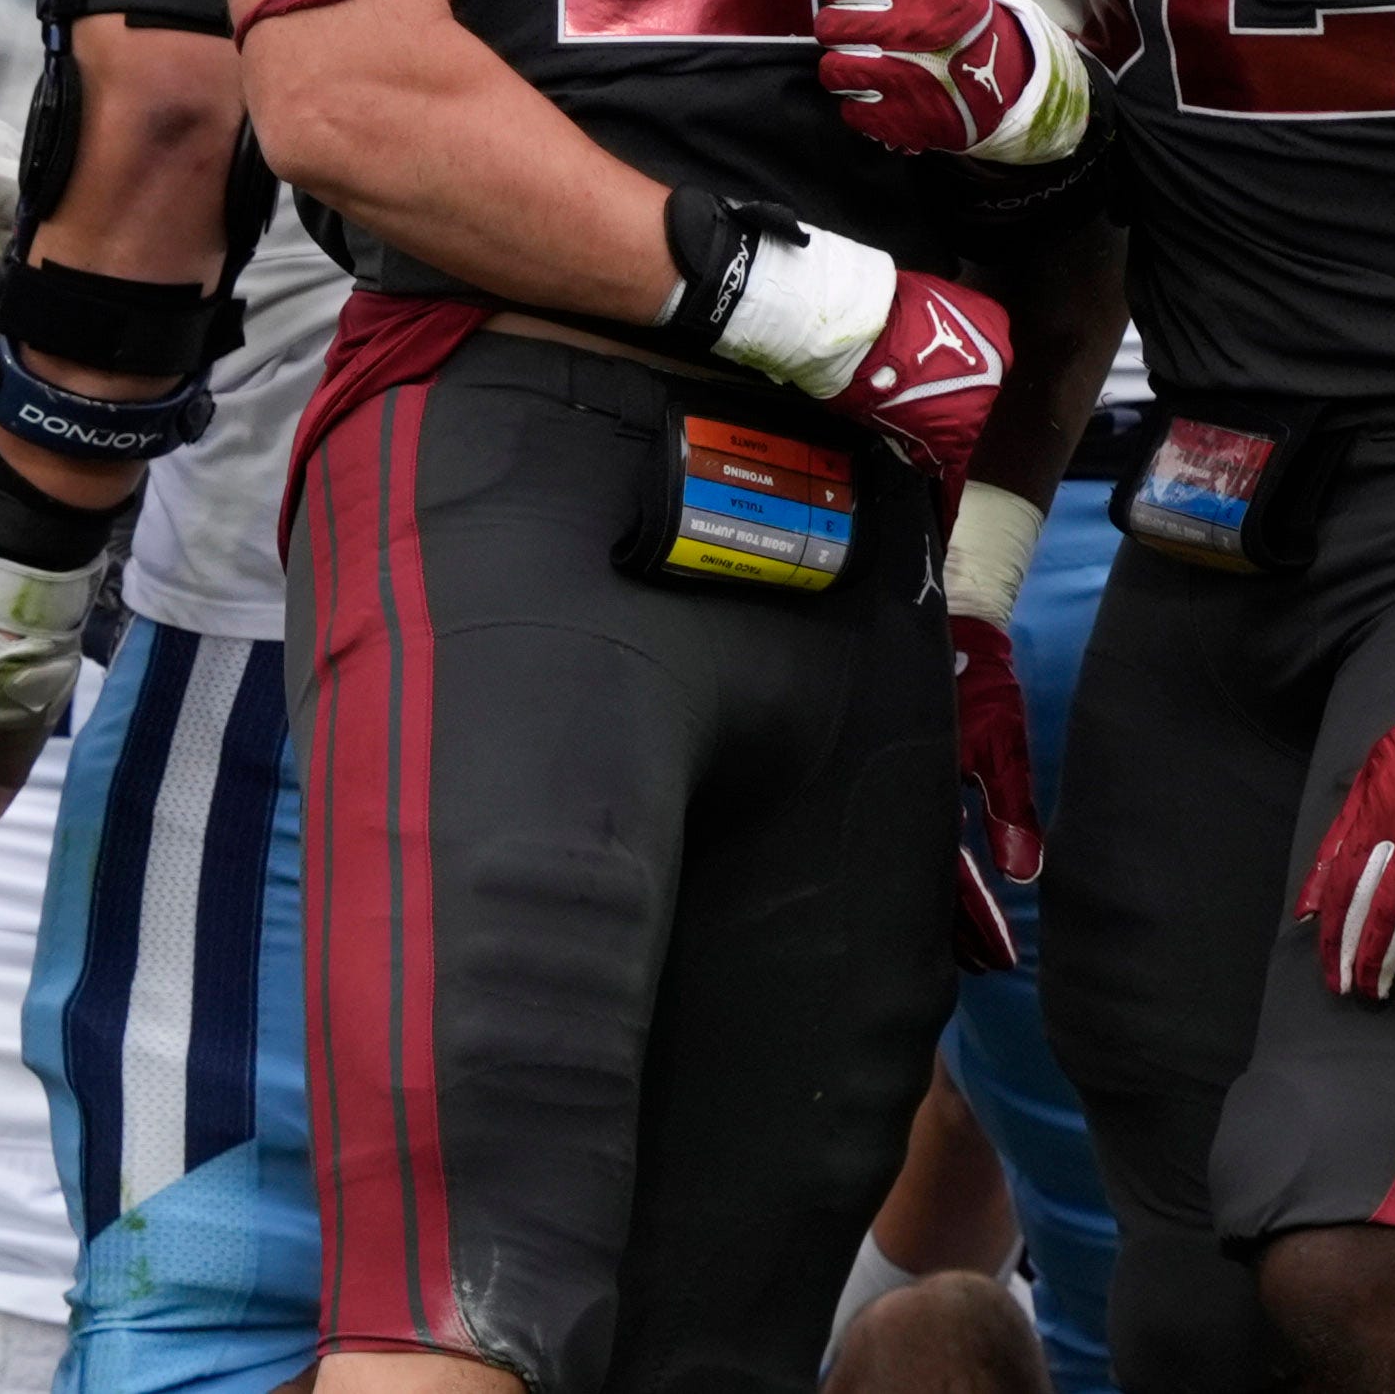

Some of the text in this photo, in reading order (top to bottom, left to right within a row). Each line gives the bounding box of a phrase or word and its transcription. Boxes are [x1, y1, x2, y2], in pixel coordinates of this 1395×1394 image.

[710, 241, 750, 324] DONJOY
[18, 403, 157, 450] DONJOY
[730, 435, 768, 454] GIANTS
[723, 464, 774, 486] WYOMING
[731, 497, 764, 514] TULSA
[825, 489, 835, 503] 4
[690, 518, 735, 539] JUPITER
[826, 520, 835, 532] 3
[736, 530, 760, 546] TOM
[699, 553, 763, 576] TACO RHINO
[817, 549, 831, 564] 2
